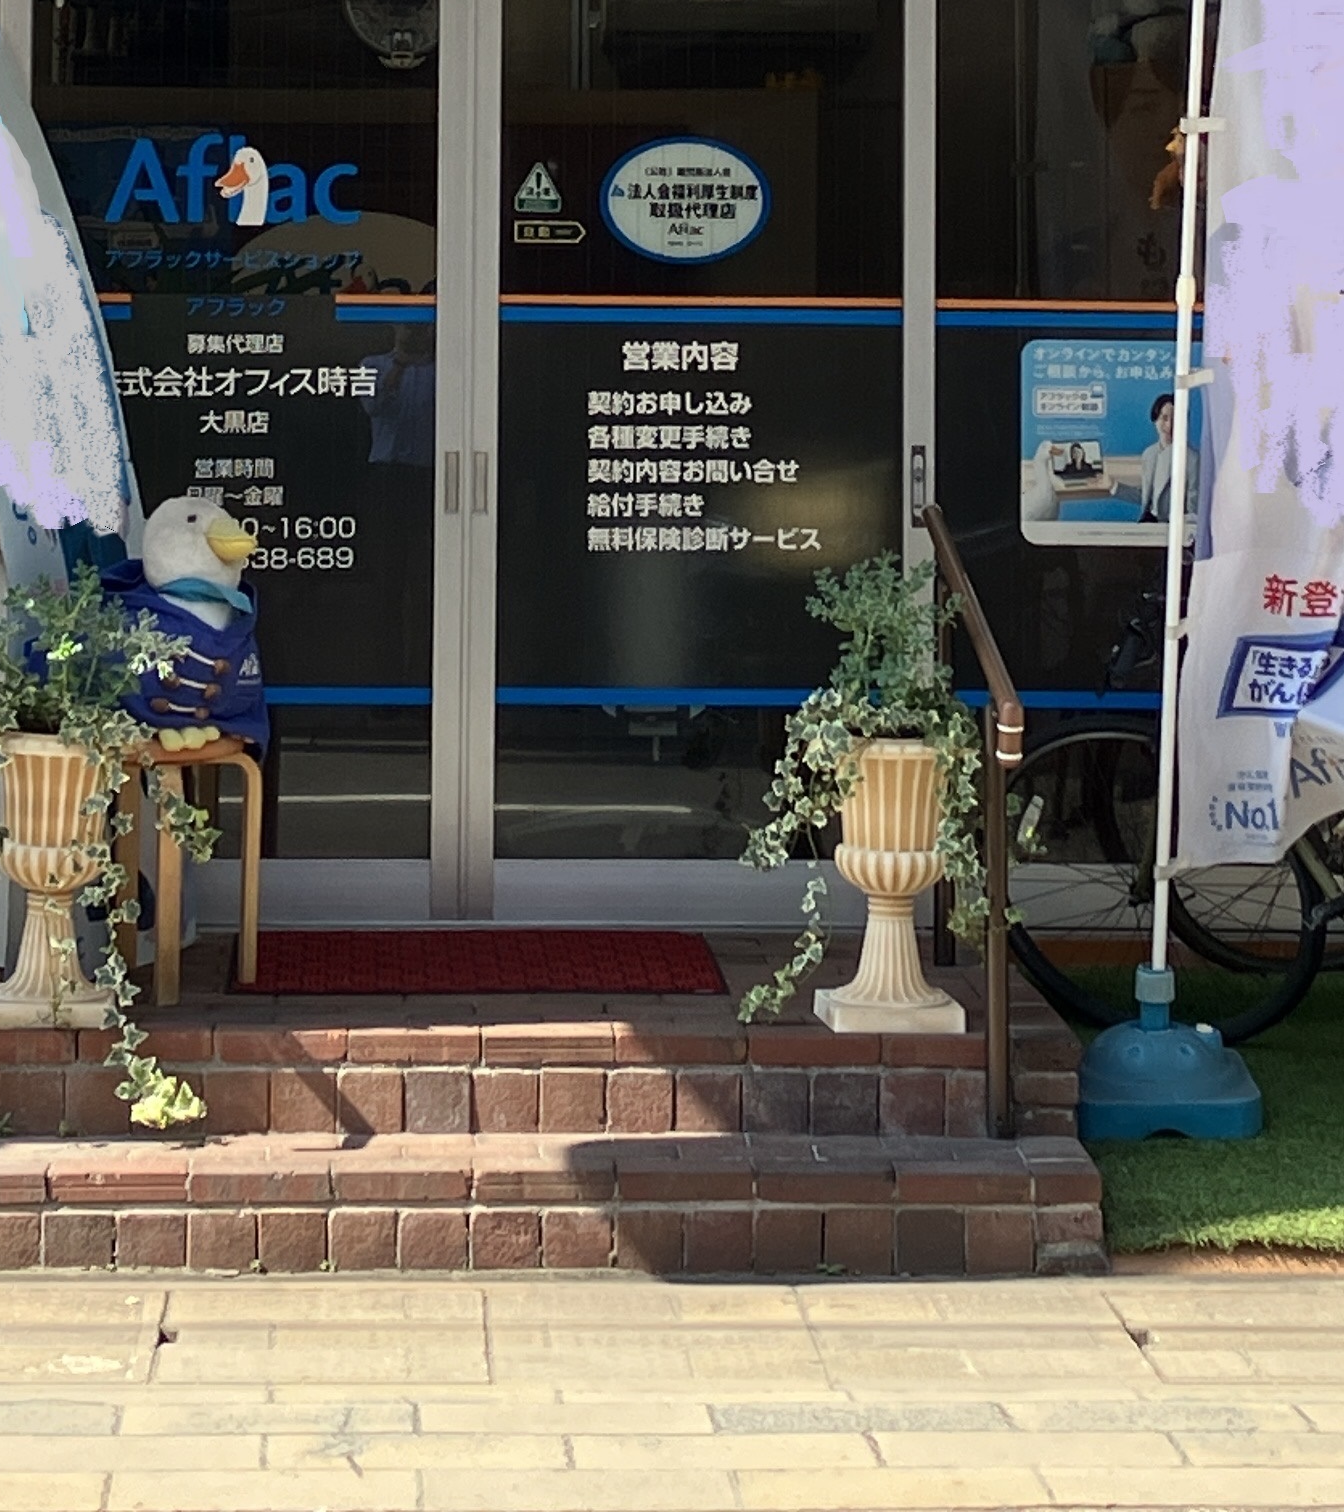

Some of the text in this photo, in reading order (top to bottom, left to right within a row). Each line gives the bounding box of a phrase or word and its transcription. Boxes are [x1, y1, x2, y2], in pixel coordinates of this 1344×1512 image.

[105, 131, 362, 226] Aflac
[186, 297, 287, 317] アフラック
[187, 333, 285, 356] 募集代理店
[621, 341, 740, 372] 営業内容
[587, 391, 753, 417] 契約お申し込み
[199, 410, 271, 435] 大黒店
[587, 426, 752, 451] 各種変更手続き
[194, 458, 275, 479] 営業時間
[587, 459, 799, 484] 契約内容お問い合せ
[586, 493, 705, 518] 給付手続き
[586, 527, 823, 553] 無料保険診断サービス
